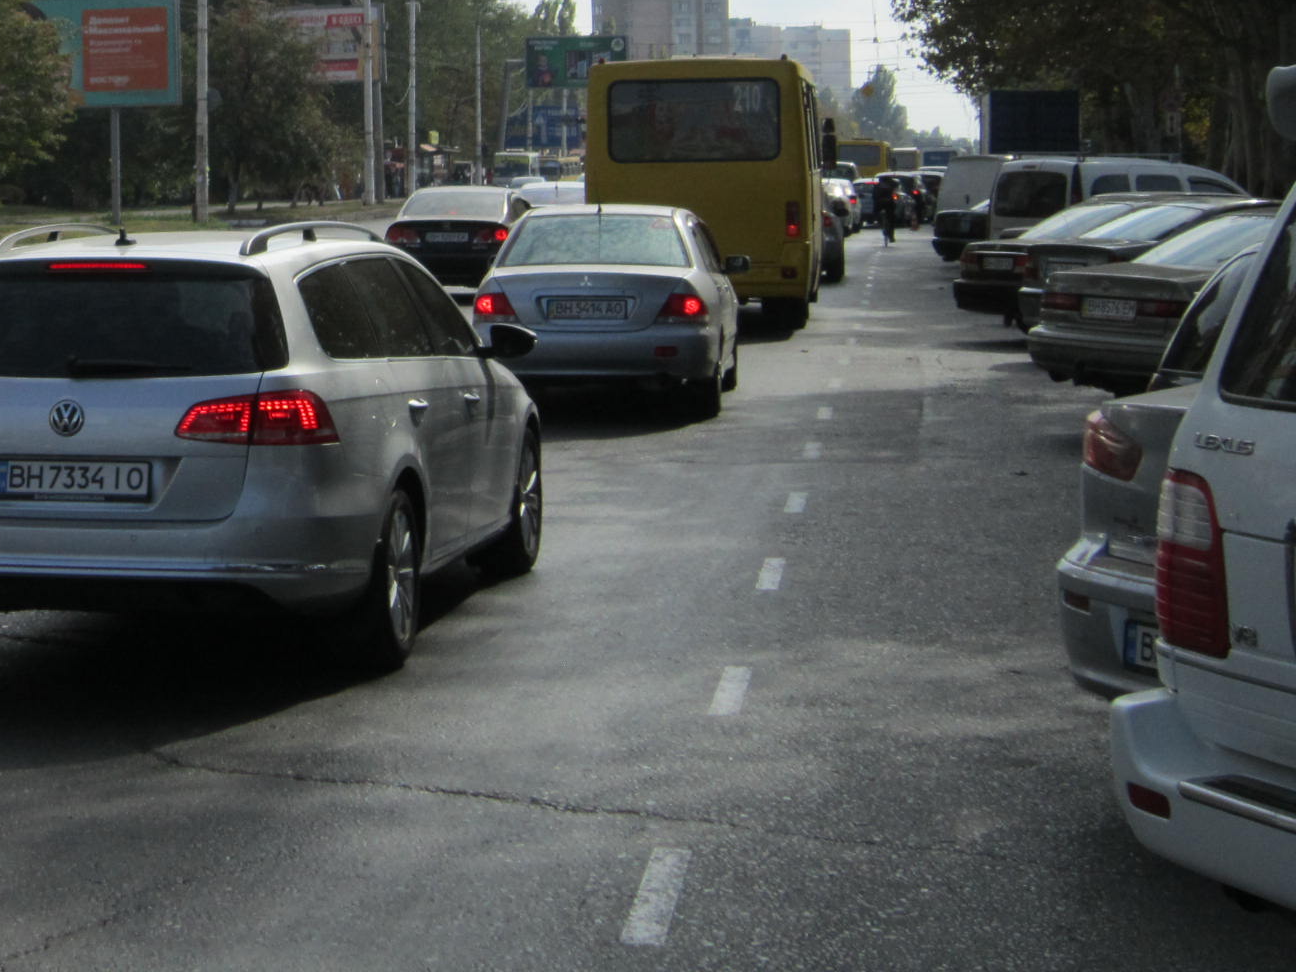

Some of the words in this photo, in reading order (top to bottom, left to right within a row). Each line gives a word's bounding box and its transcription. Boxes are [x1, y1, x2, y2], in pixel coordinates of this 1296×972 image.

[734, 85, 761, 111] 210
[1194, 432, 1256, 456] LEXUS
[9, 465, 43, 489] BH
[49, 465, 104, 490] 7334
